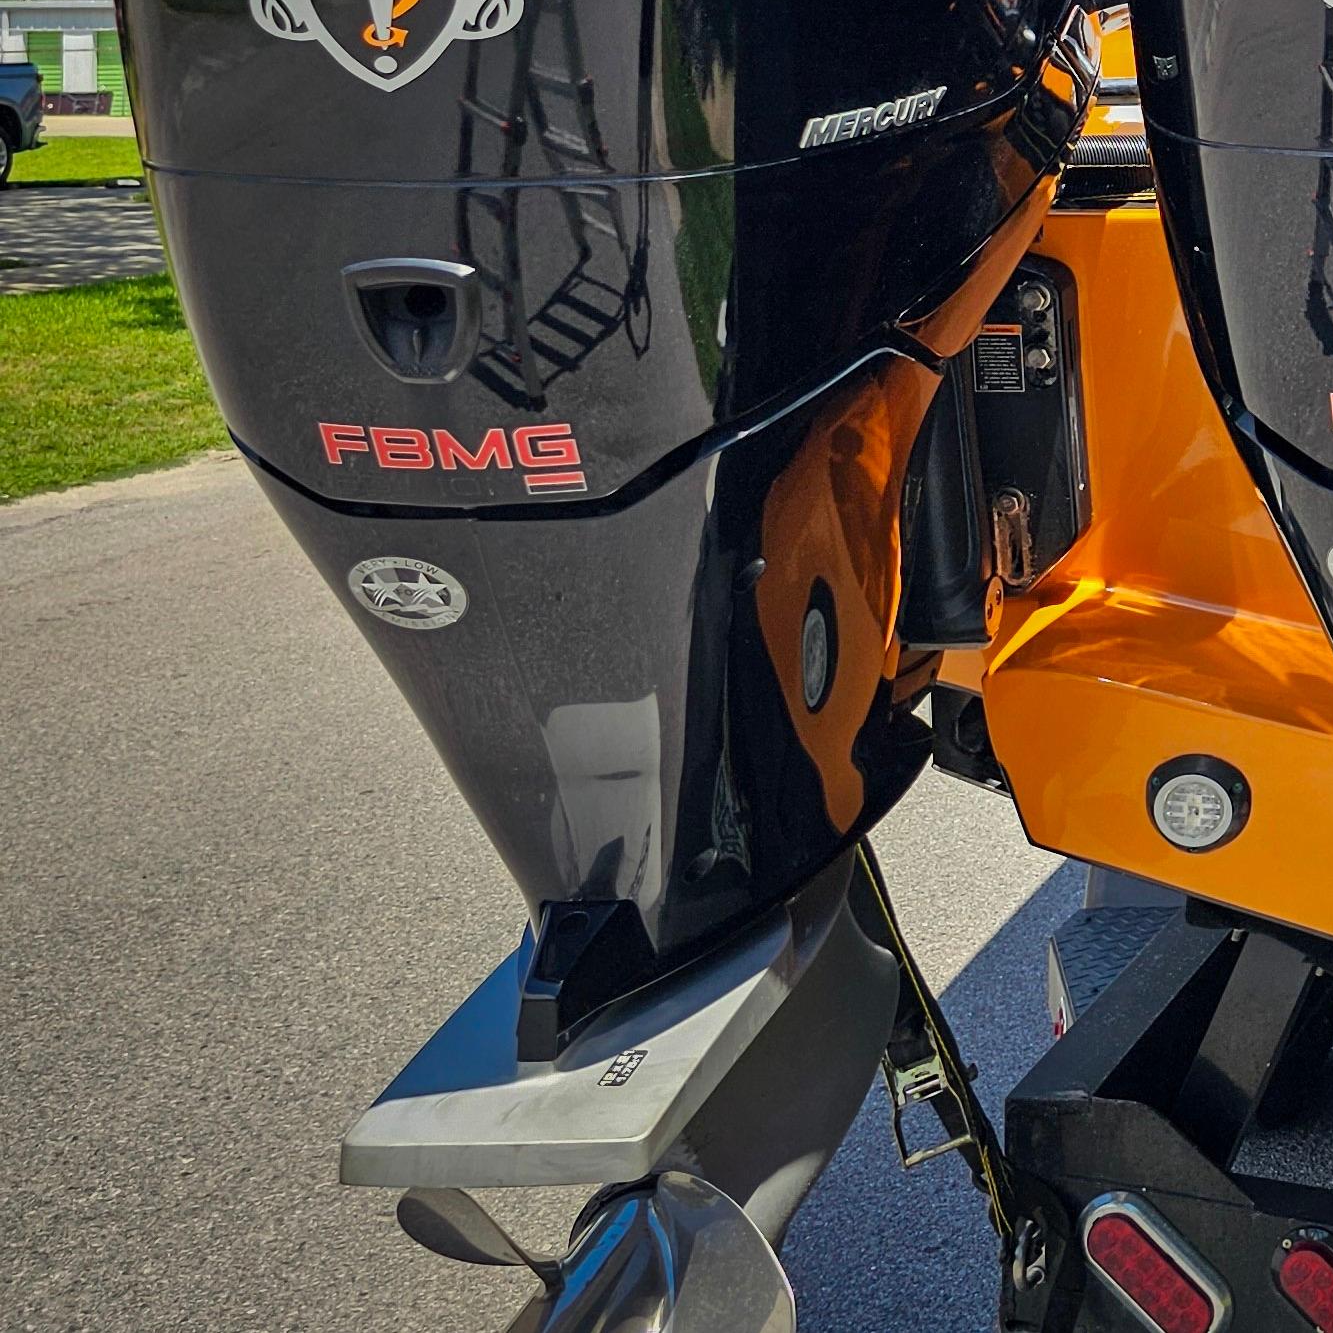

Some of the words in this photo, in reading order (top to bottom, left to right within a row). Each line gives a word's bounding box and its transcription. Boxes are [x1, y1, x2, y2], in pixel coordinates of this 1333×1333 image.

[799, 85, 948, 149] MERCURY
[318, 422, 581, 471] FBMG
[404, 560, 439, 575] LOW
